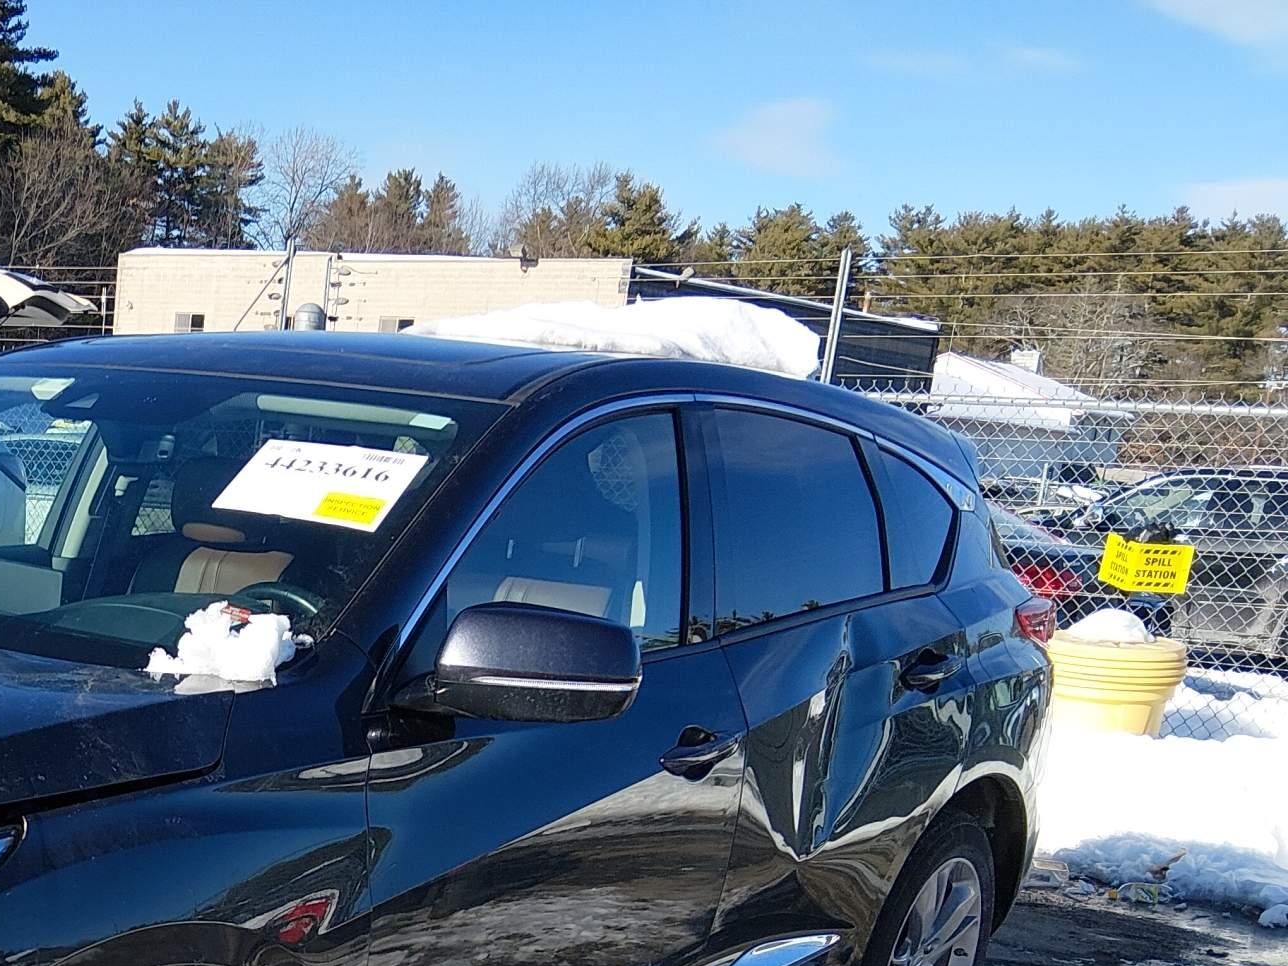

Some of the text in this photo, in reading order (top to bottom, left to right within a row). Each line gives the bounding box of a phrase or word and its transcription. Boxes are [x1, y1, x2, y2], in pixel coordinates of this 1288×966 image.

[266, 457, 390, 482] 44233616
[1144, 557, 1172, 567] SPILL
[1134, 569, 1176, 580] STATION
